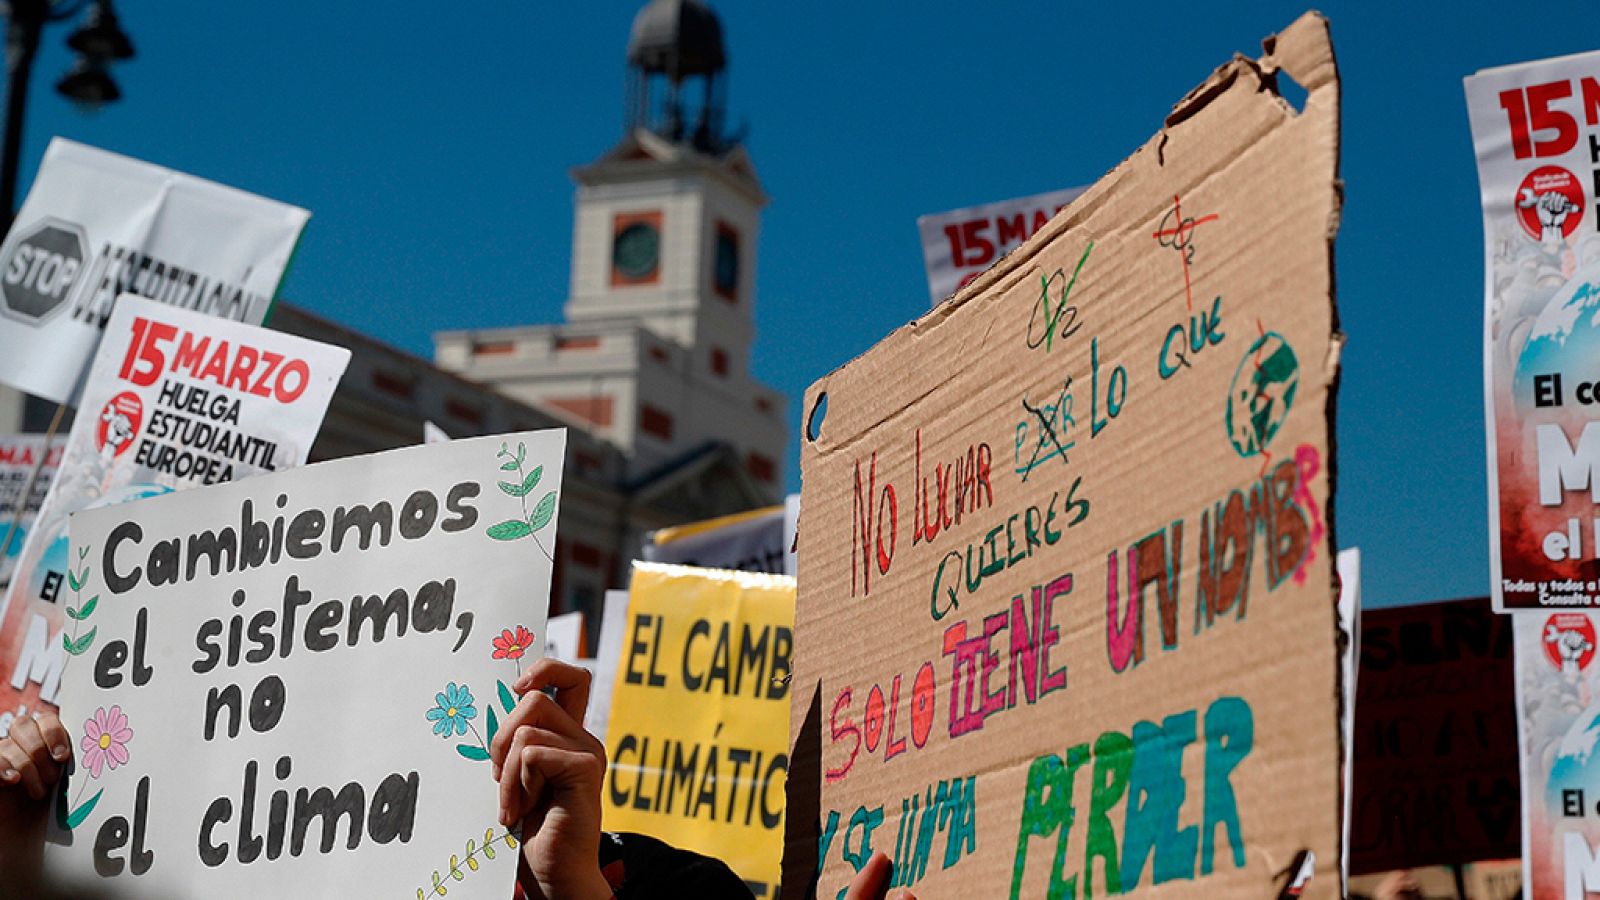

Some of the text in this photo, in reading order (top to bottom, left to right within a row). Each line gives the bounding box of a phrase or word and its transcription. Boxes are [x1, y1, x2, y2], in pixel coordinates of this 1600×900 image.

[1498, 79, 1579, 160] 15
[3, 242, 82, 299] STOP
[944, 219, 995, 269] 15
[118, 316, 311, 404] 15 MARZO
[1534, 372, 1564, 409] El
[146, 408, 279, 472] ESTUDIANTIL
[157, 379, 243, 426] HUELGA
[912, 427, 993, 547] LUCHAR
[1090, 336, 1127, 440] LO
[1158, 295, 1226, 380] QUE
[134, 438, 235, 485] EUROPEA
[102, 480, 481, 595] Cambiemos
[930, 476, 1090, 622] QUIERES
[40, 570, 65, 604] El
[93, 574, 474, 689] el sistema,
[624, 613, 793, 701] EL CAMB
[825, 660, 937, 784] SOLO
[941, 572, 1074, 740] TIENE
[1106, 518, 1184, 674] UN
[203, 674, 287, 741] no
[93, 755, 420, 878] el clima
[1008, 696, 1254, 900] PERDER
[1562, 788, 1585, 817] El
